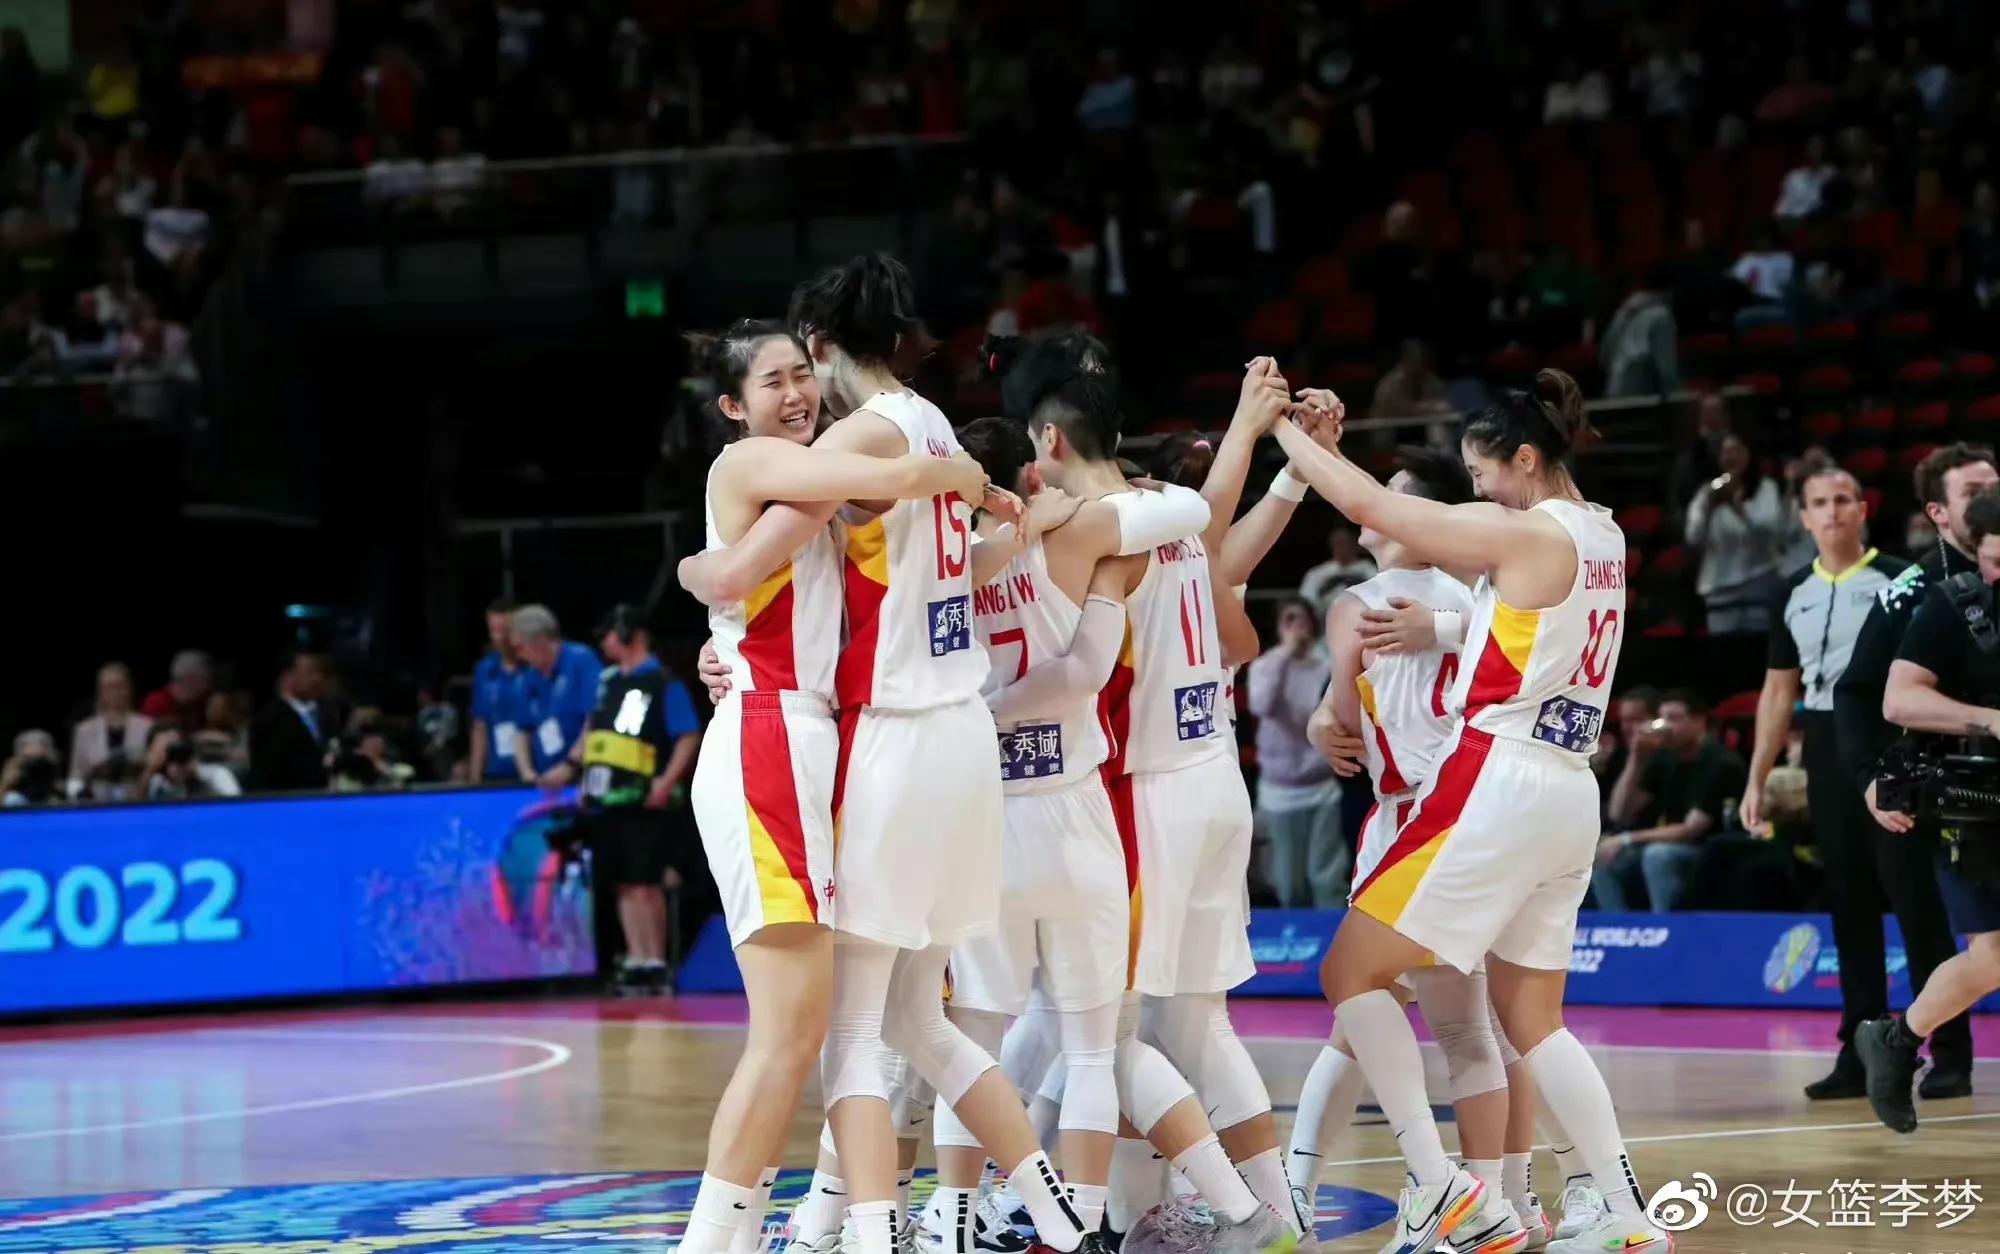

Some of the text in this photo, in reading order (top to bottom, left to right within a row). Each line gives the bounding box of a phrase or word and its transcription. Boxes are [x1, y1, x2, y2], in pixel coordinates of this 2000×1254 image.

[933, 491, 966, 580] 15
[974, 583, 1006, 617] ANG
[1180, 579, 1205, 667] 11
[989, 627, 1028, 687] 7
[1568, 609, 1618, 689] 10
[1014, 730, 1060, 762] 秀域
[0, 859, 242, 952] 2022
